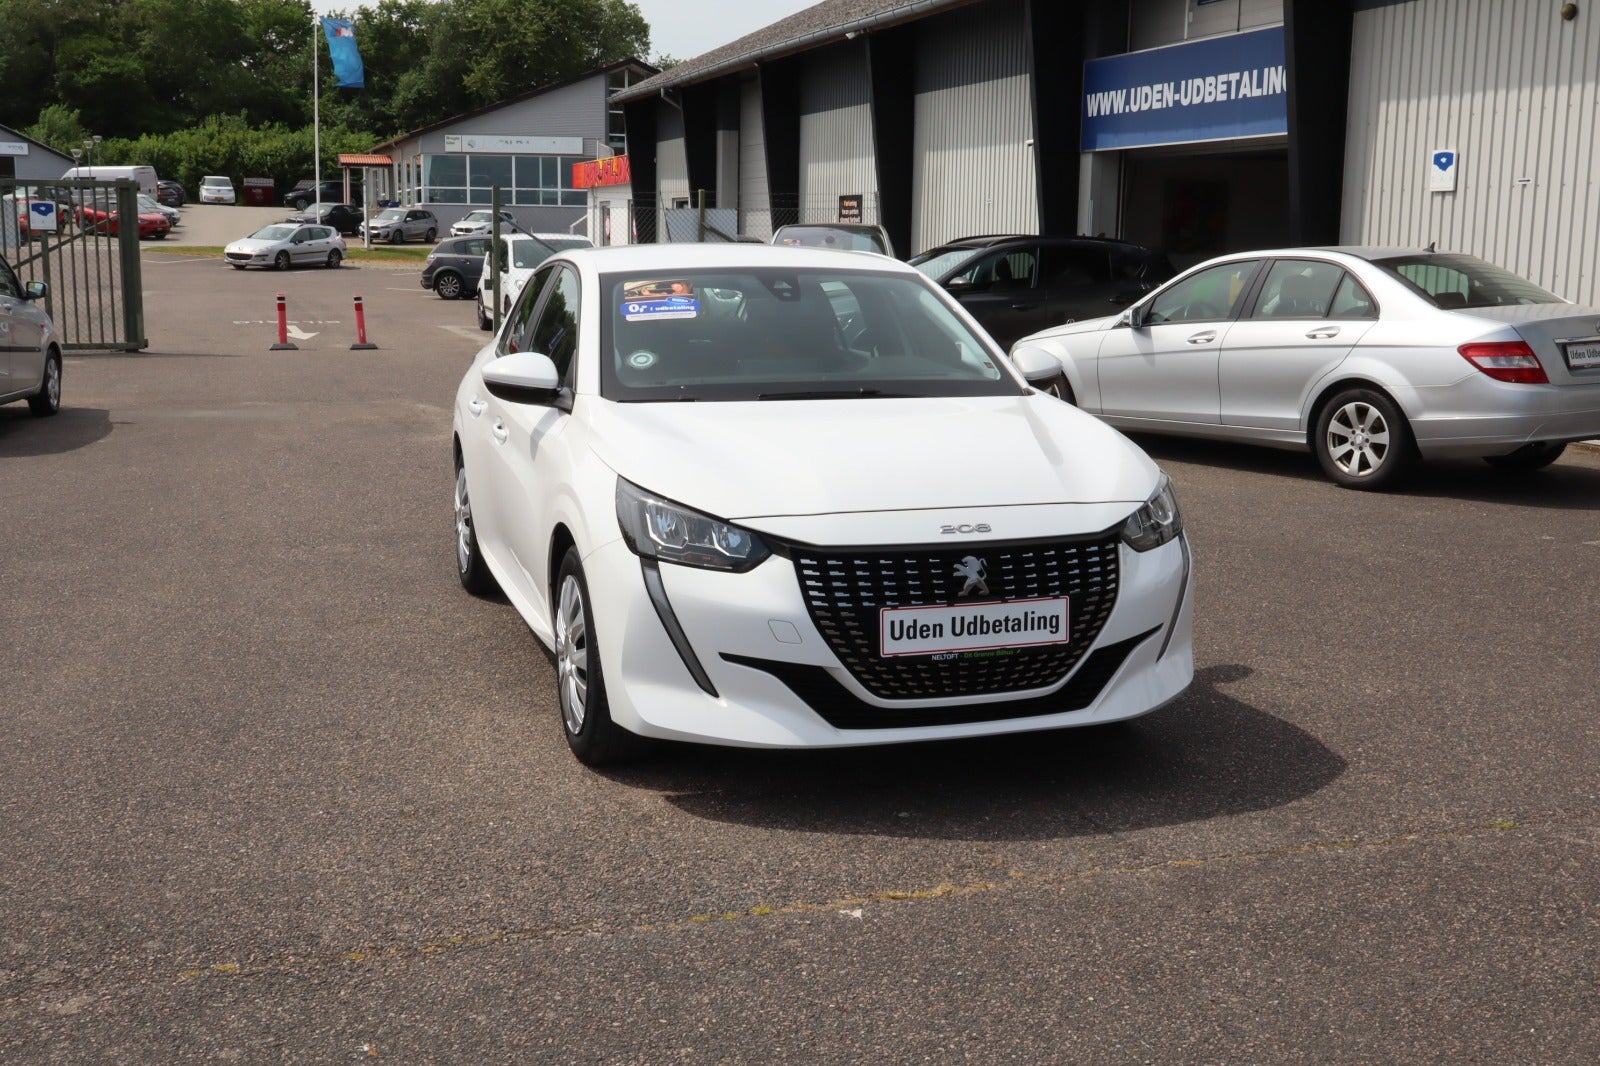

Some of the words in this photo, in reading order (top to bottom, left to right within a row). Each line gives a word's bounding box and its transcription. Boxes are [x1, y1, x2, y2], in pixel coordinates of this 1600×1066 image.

[939, 523, 992, 534] 208
[890, 619, 943, 641] Uden
[951, 611, 1060, 635] Udbetaling
[931, 653, 960, 661] NELTOFT
